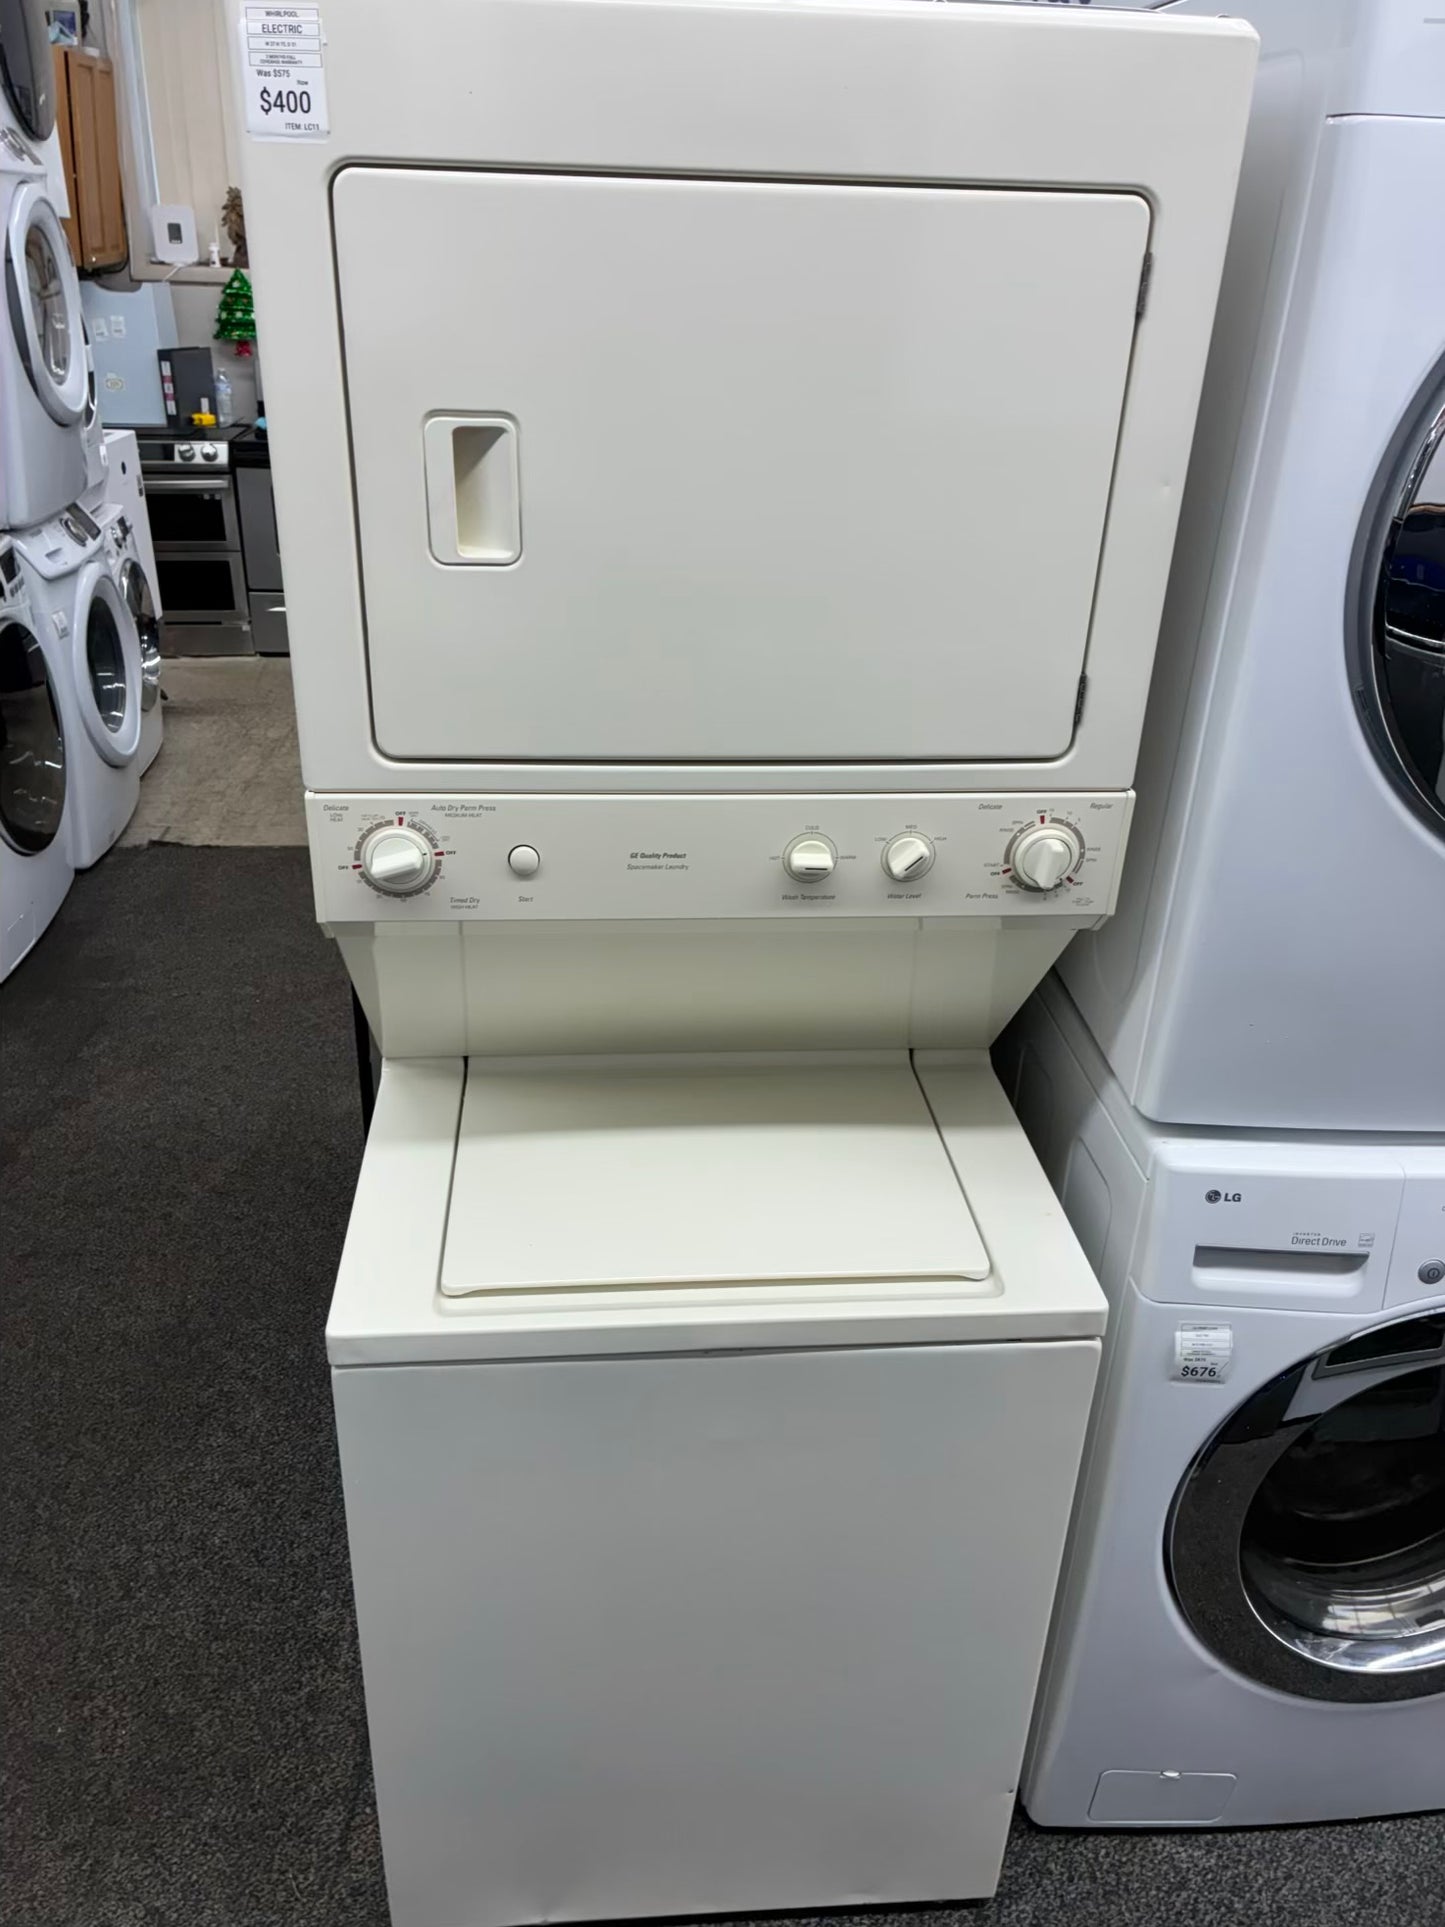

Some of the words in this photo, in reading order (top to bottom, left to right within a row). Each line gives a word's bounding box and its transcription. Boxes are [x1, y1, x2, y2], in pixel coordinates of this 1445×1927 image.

[265, 10, 300, 18] WHIRLPOOL
[262, 24, 303, 34] ELECTRIC
[256, 69, 272, 77] Was
[273, 69, 291, 78] $575
[260, 86, 311, 115] $400
[447, 804, 459, 812] Dry
[460, 804, 477, 812] Perm
[478, 804, 496, 812] Press
[640, 852, 661, 860] Quality
[466, 897, 480, 905] Dry
[1224, 1192, 1242, 1203] LG
[1292, 1236, 1320, 1246] Direct
[1322, 1237, 1347, 1247] Drive
[1181, 1366, 1216, 1377] $676
